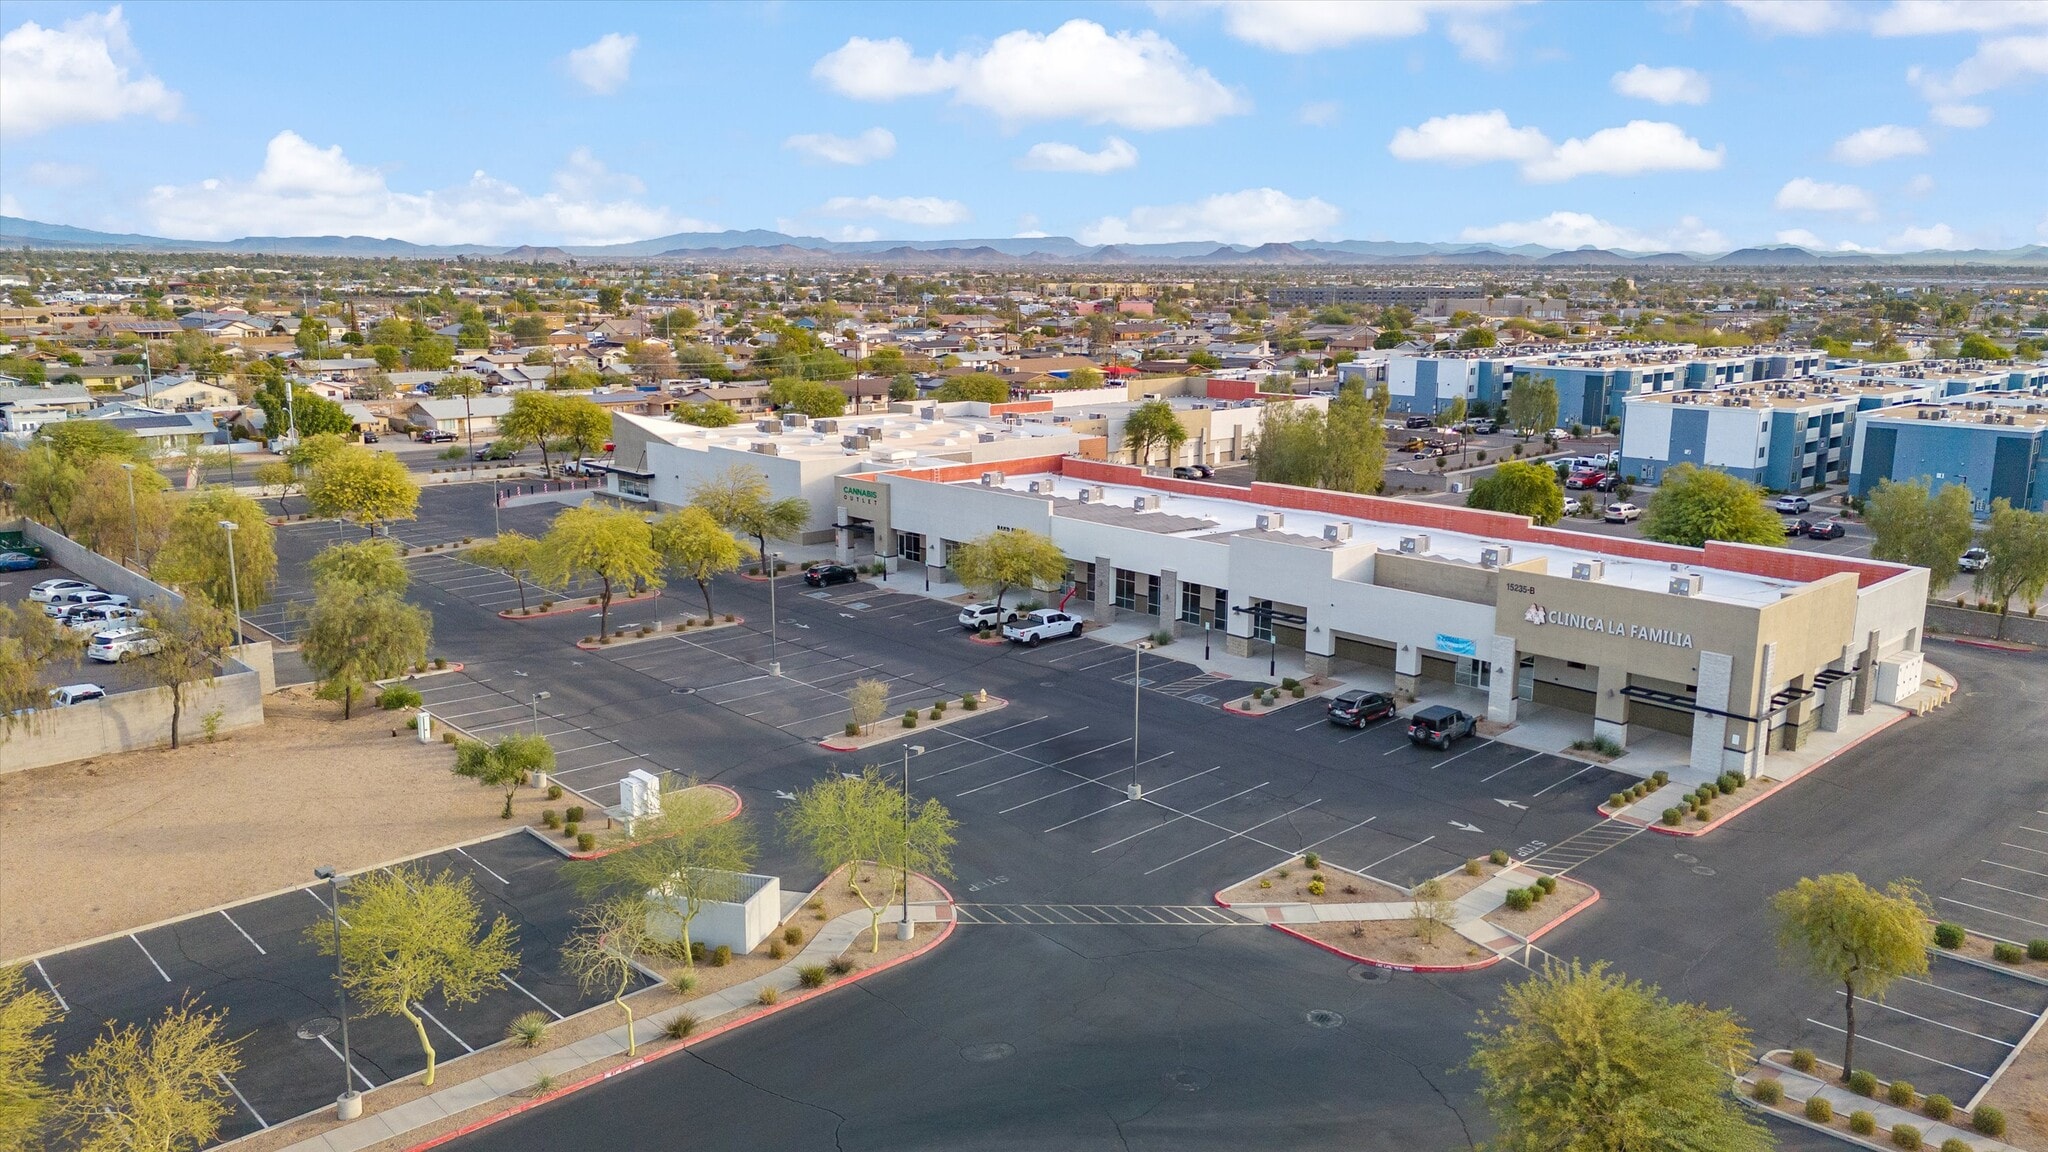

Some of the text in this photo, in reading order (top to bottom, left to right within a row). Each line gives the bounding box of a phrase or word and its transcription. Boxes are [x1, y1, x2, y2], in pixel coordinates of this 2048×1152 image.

[843, 486, 877, 499] CANNABIS
[843, 494, 878, 506] OUTLET
[1506, 583, 1535, 595] 15235-B
[1548, 610, 1693, 648] CLINICA LA FAMILIA
[1514, 840, 1547, 857] STOP
